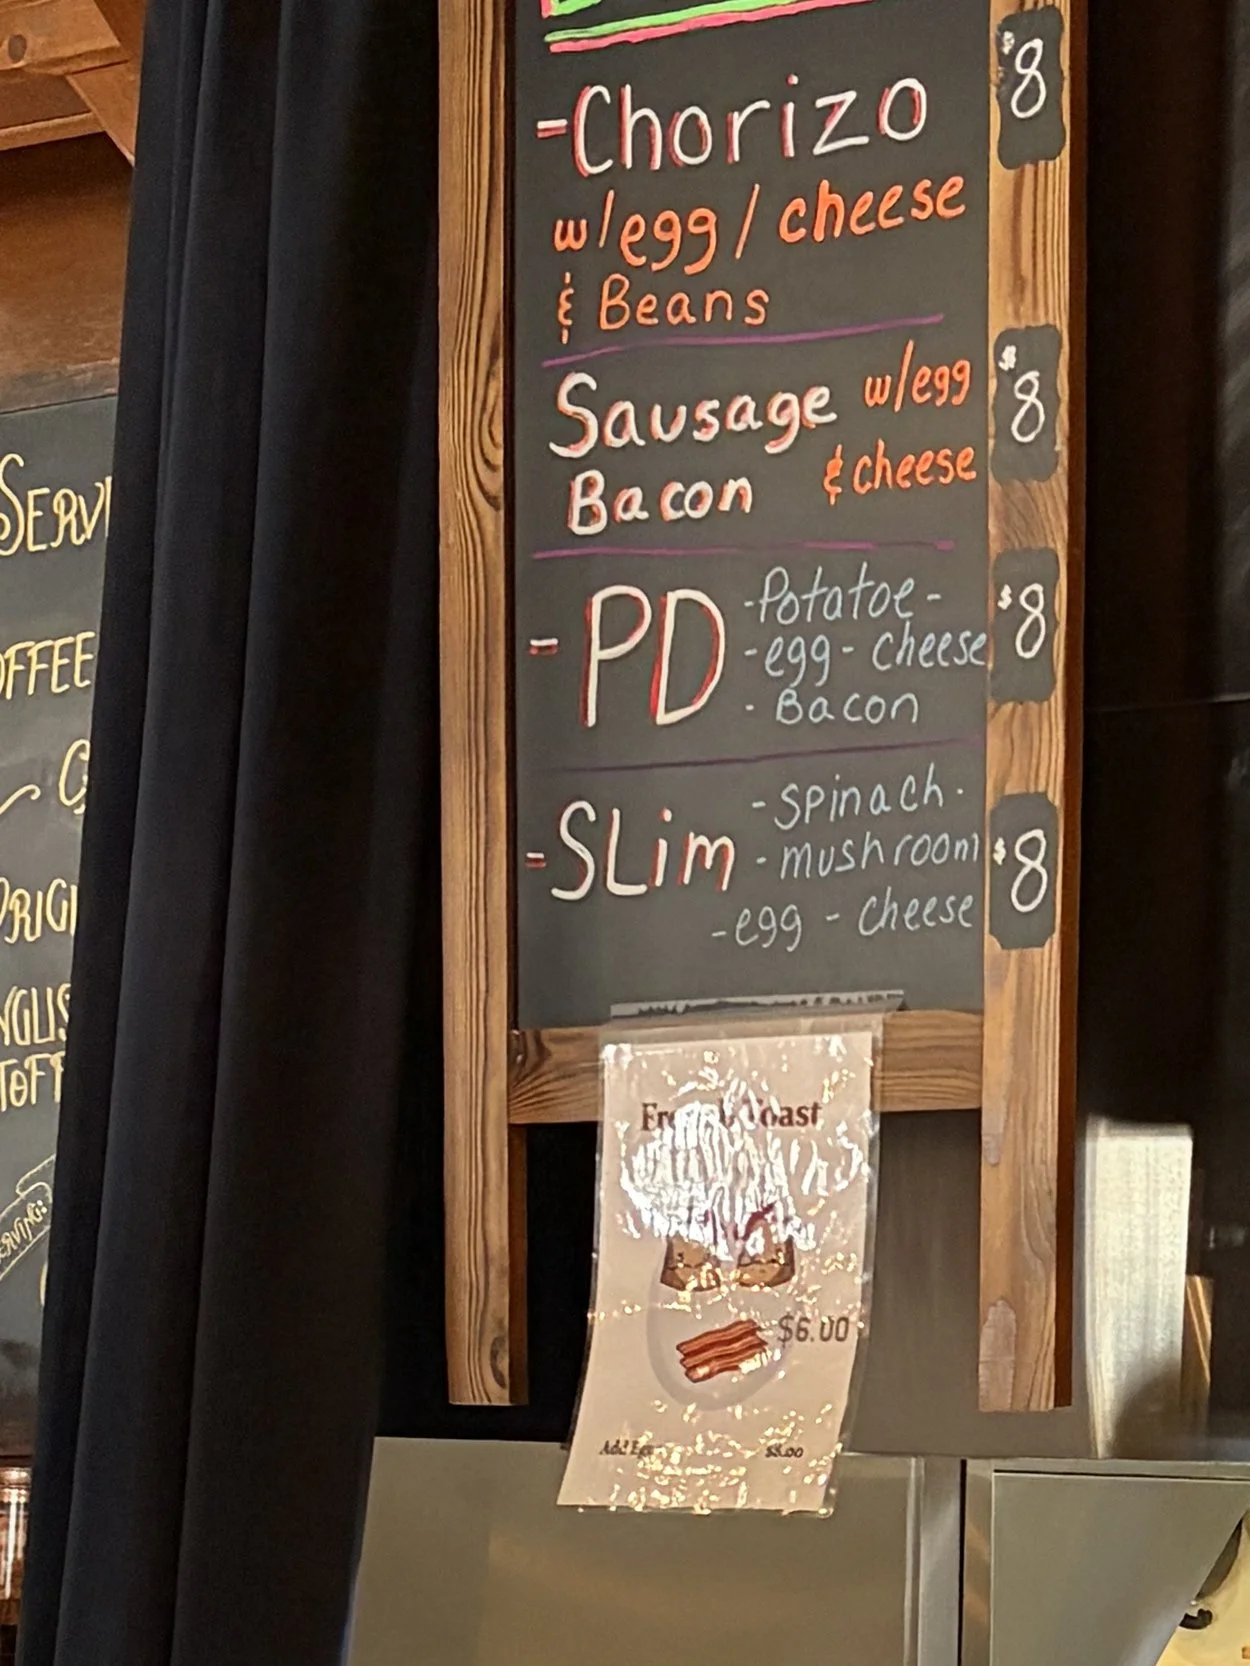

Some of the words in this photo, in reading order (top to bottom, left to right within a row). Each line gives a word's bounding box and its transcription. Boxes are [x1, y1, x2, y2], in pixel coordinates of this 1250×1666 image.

[780, 176, 965, 243] cheese
[598, 272, 769, 329] Beans
[549, 373, 838, 458] Sausage
[864, 340, 970, 412] w/egg
[568, 470, 752, 538] Bacon
[854, 439, 976, 494] cheese
[998, 582, 1046, 659] $8
[0, 630, 97, 700] FFEE
[992, 828, 1048, 914] $8
[778, 1312, 849, 1348] $6.00
